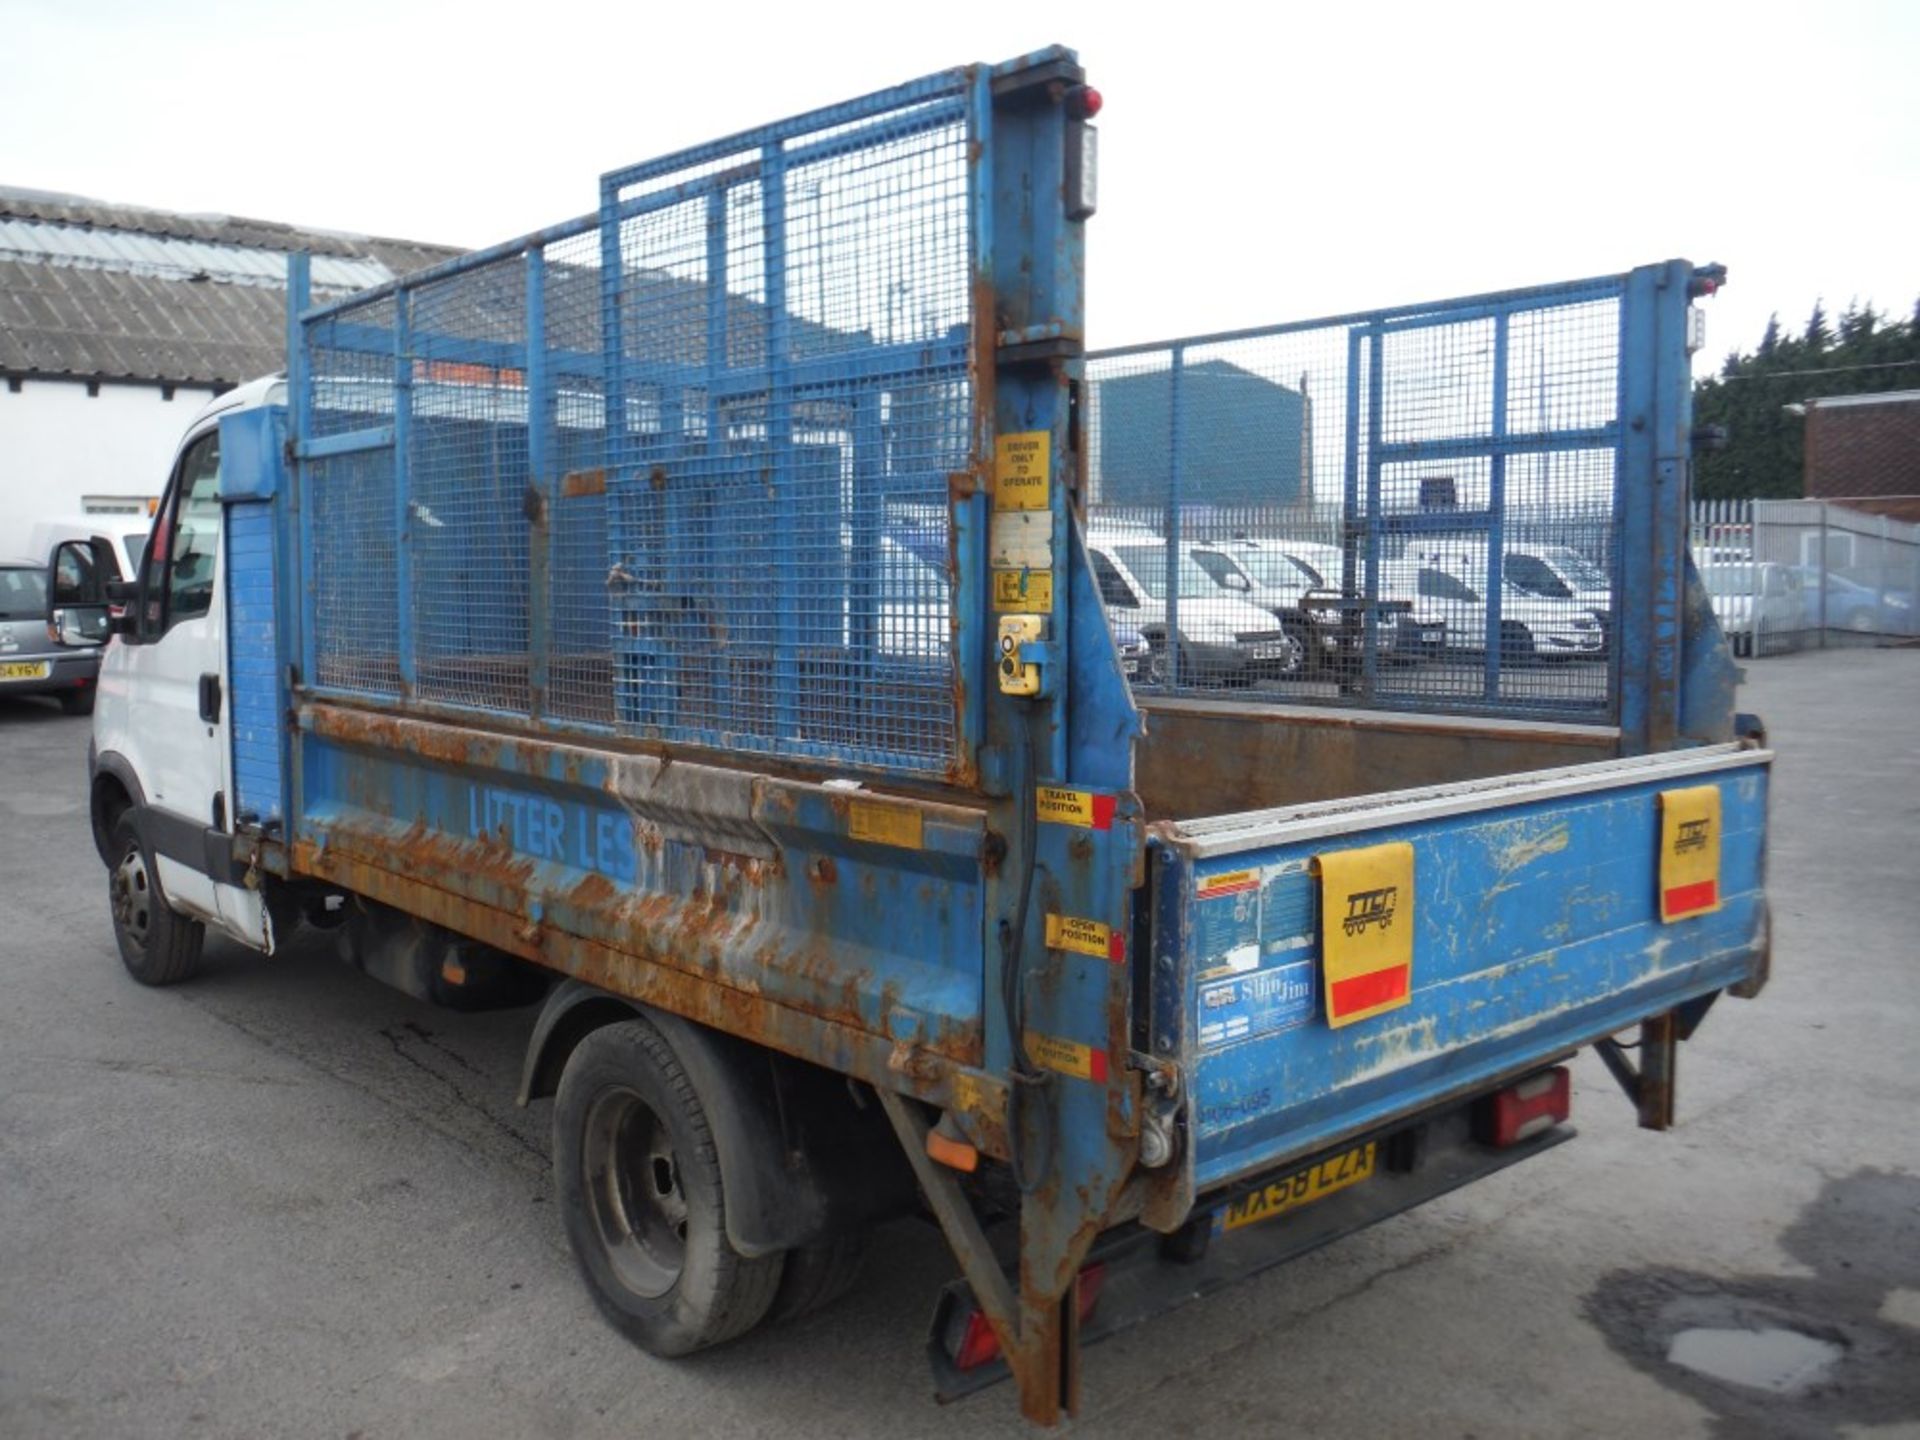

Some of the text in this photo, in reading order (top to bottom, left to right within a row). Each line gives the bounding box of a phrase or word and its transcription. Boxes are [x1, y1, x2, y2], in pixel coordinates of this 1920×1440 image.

[1007, 441, 1039, 452] DRIVER
[1011, 453, 1035, 463] ONLY
[1017, 465, 1029, 475] TO
[1003, 476, 1042, 487] OPERATE
[1044, 788, 1077, 802] TRAVEL
[1040, 799, 1082, 814] POSITION
[469, 784, 565, 861] LITTER
[1070, 919, 1096, 931] OPEN
[1061, 928, 1105, 946] POSITION
[1278, 980, 1310, 1003] Jim
